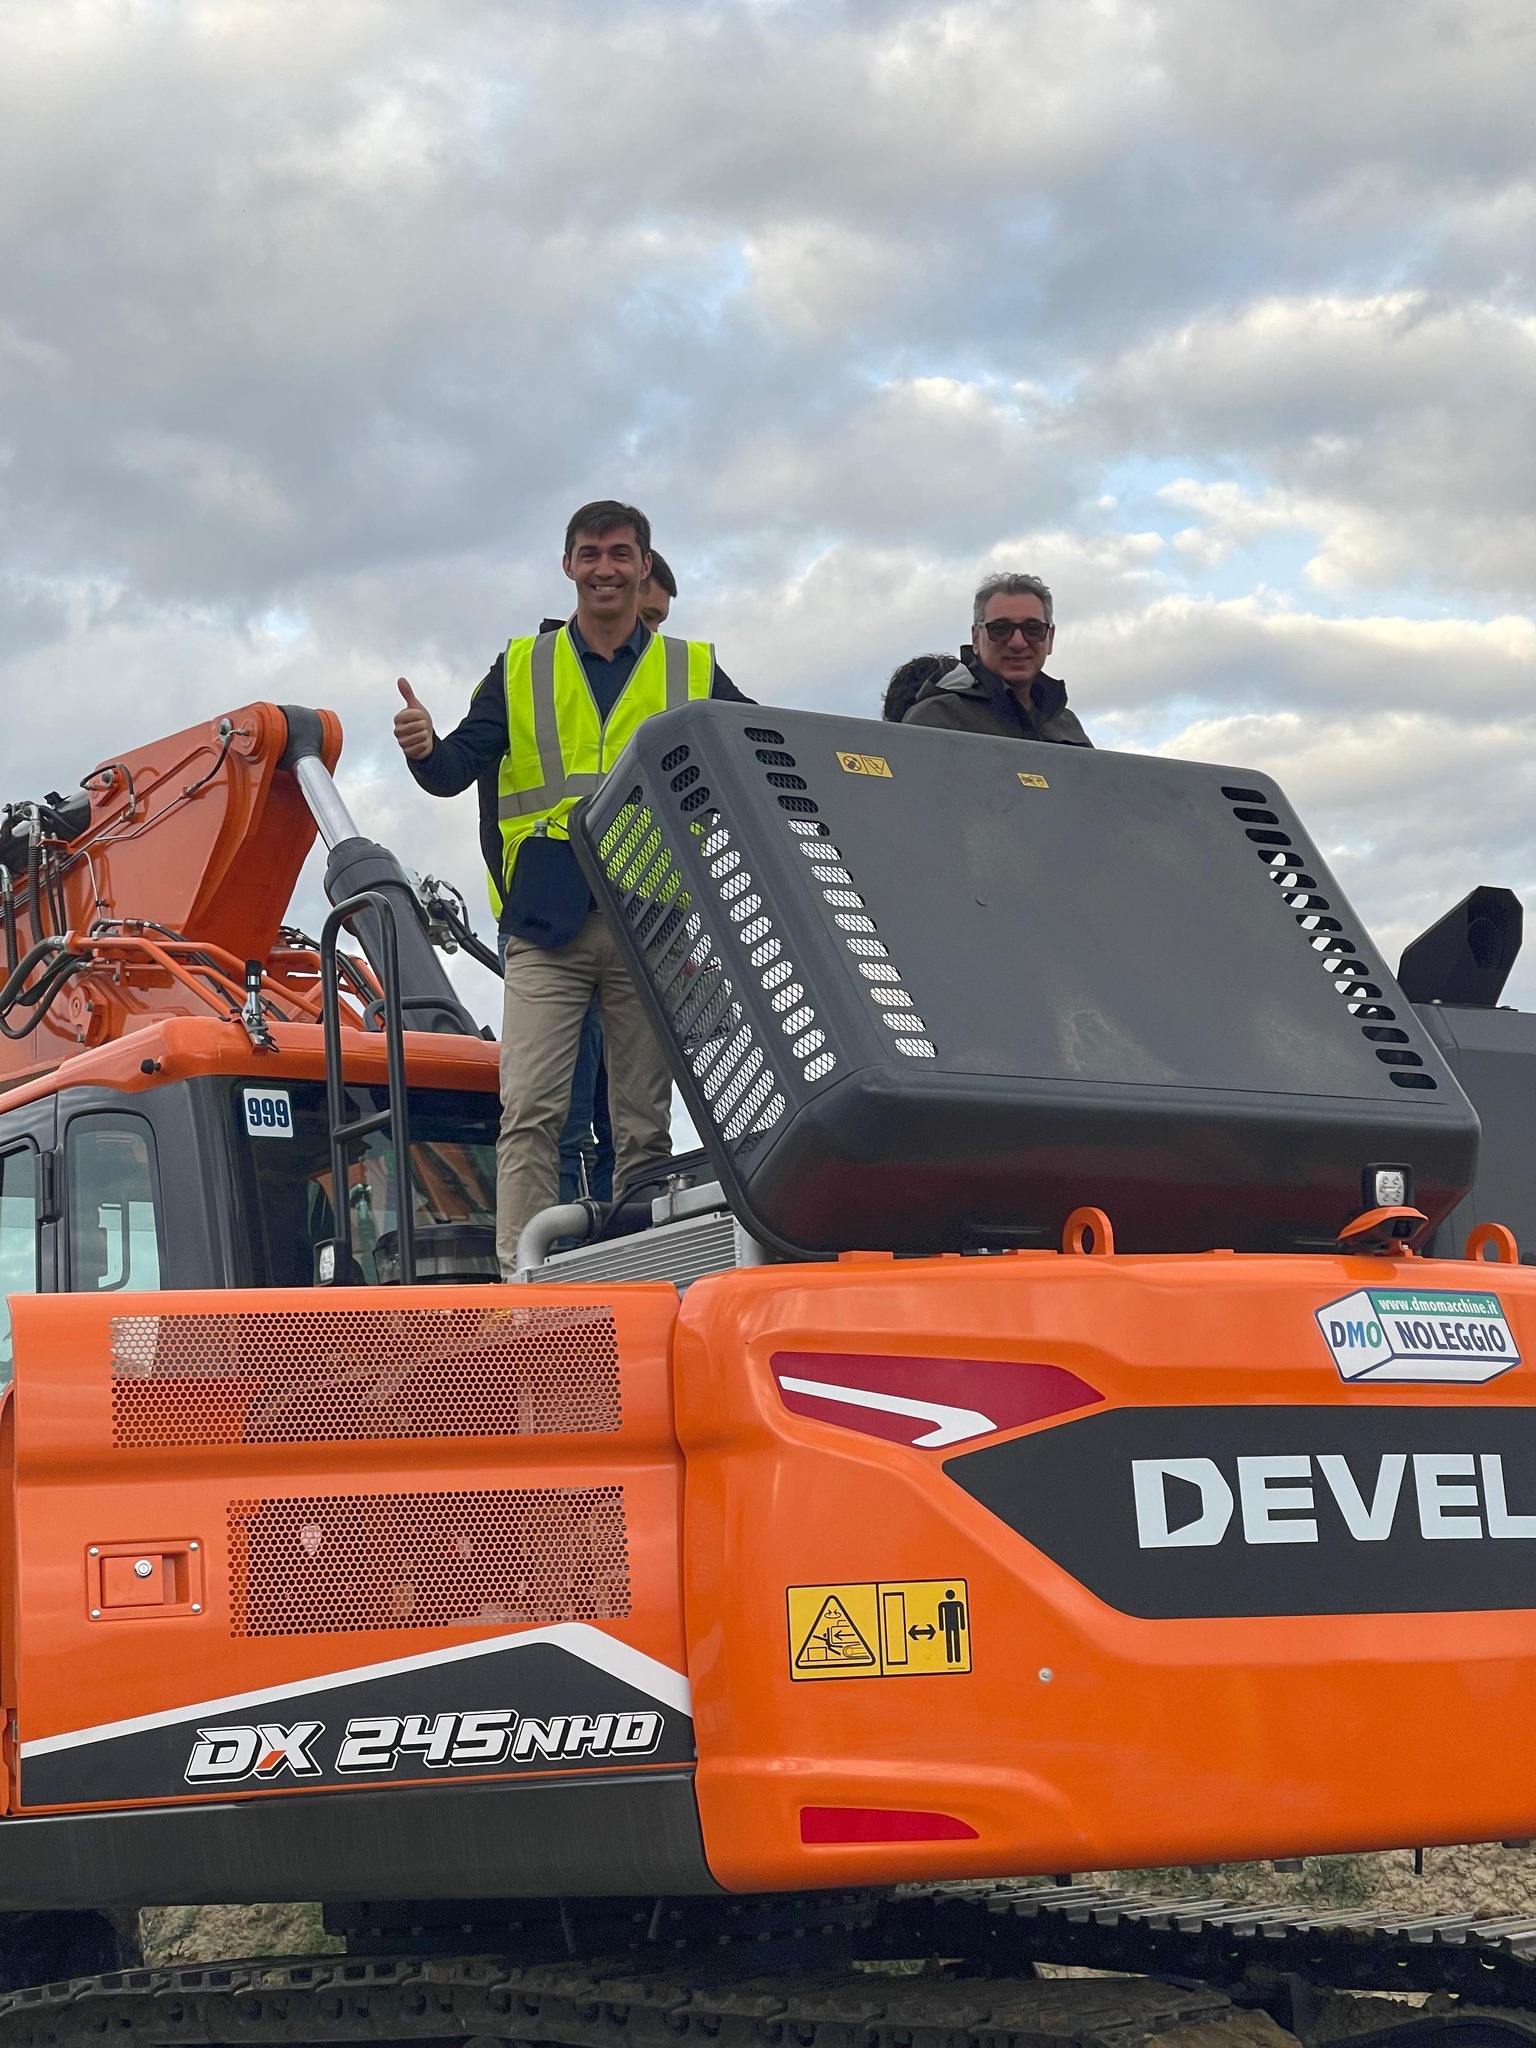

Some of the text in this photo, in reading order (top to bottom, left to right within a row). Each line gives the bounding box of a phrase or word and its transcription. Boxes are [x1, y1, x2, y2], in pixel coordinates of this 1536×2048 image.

[247, 1097, 290, 1128] 999
[1378, 1296, 1499, 1315] www.dmomacchine.it
[1329, 1320, 1507, 1353] DMO NOLEGGIO
[1131, 1453, 1536, 1549] DEVEL
[184, 1720, 326, 1785] DX
